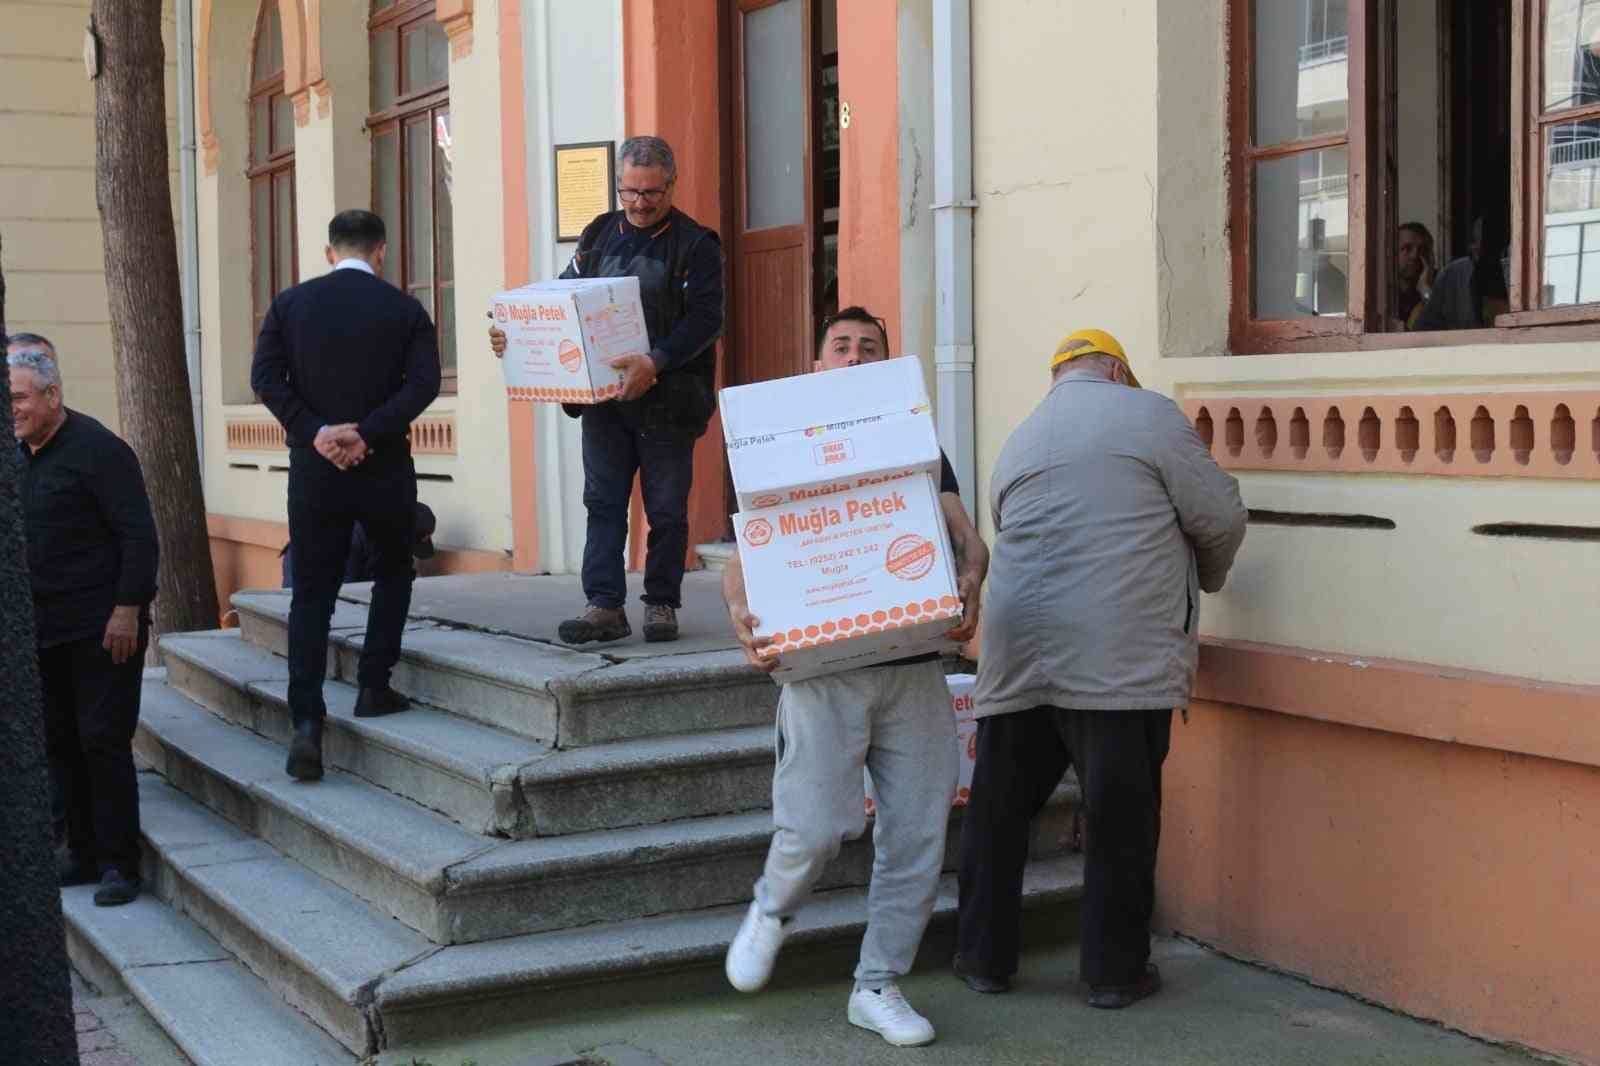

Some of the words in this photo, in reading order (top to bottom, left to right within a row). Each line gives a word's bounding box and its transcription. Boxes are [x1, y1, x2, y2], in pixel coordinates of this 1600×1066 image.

[840, 102, 850, 129] 8
[538, 304, 567, 321] Petek
[779, 505, 842, 536] Muğla
[846, 491, 907, 522] Petek
